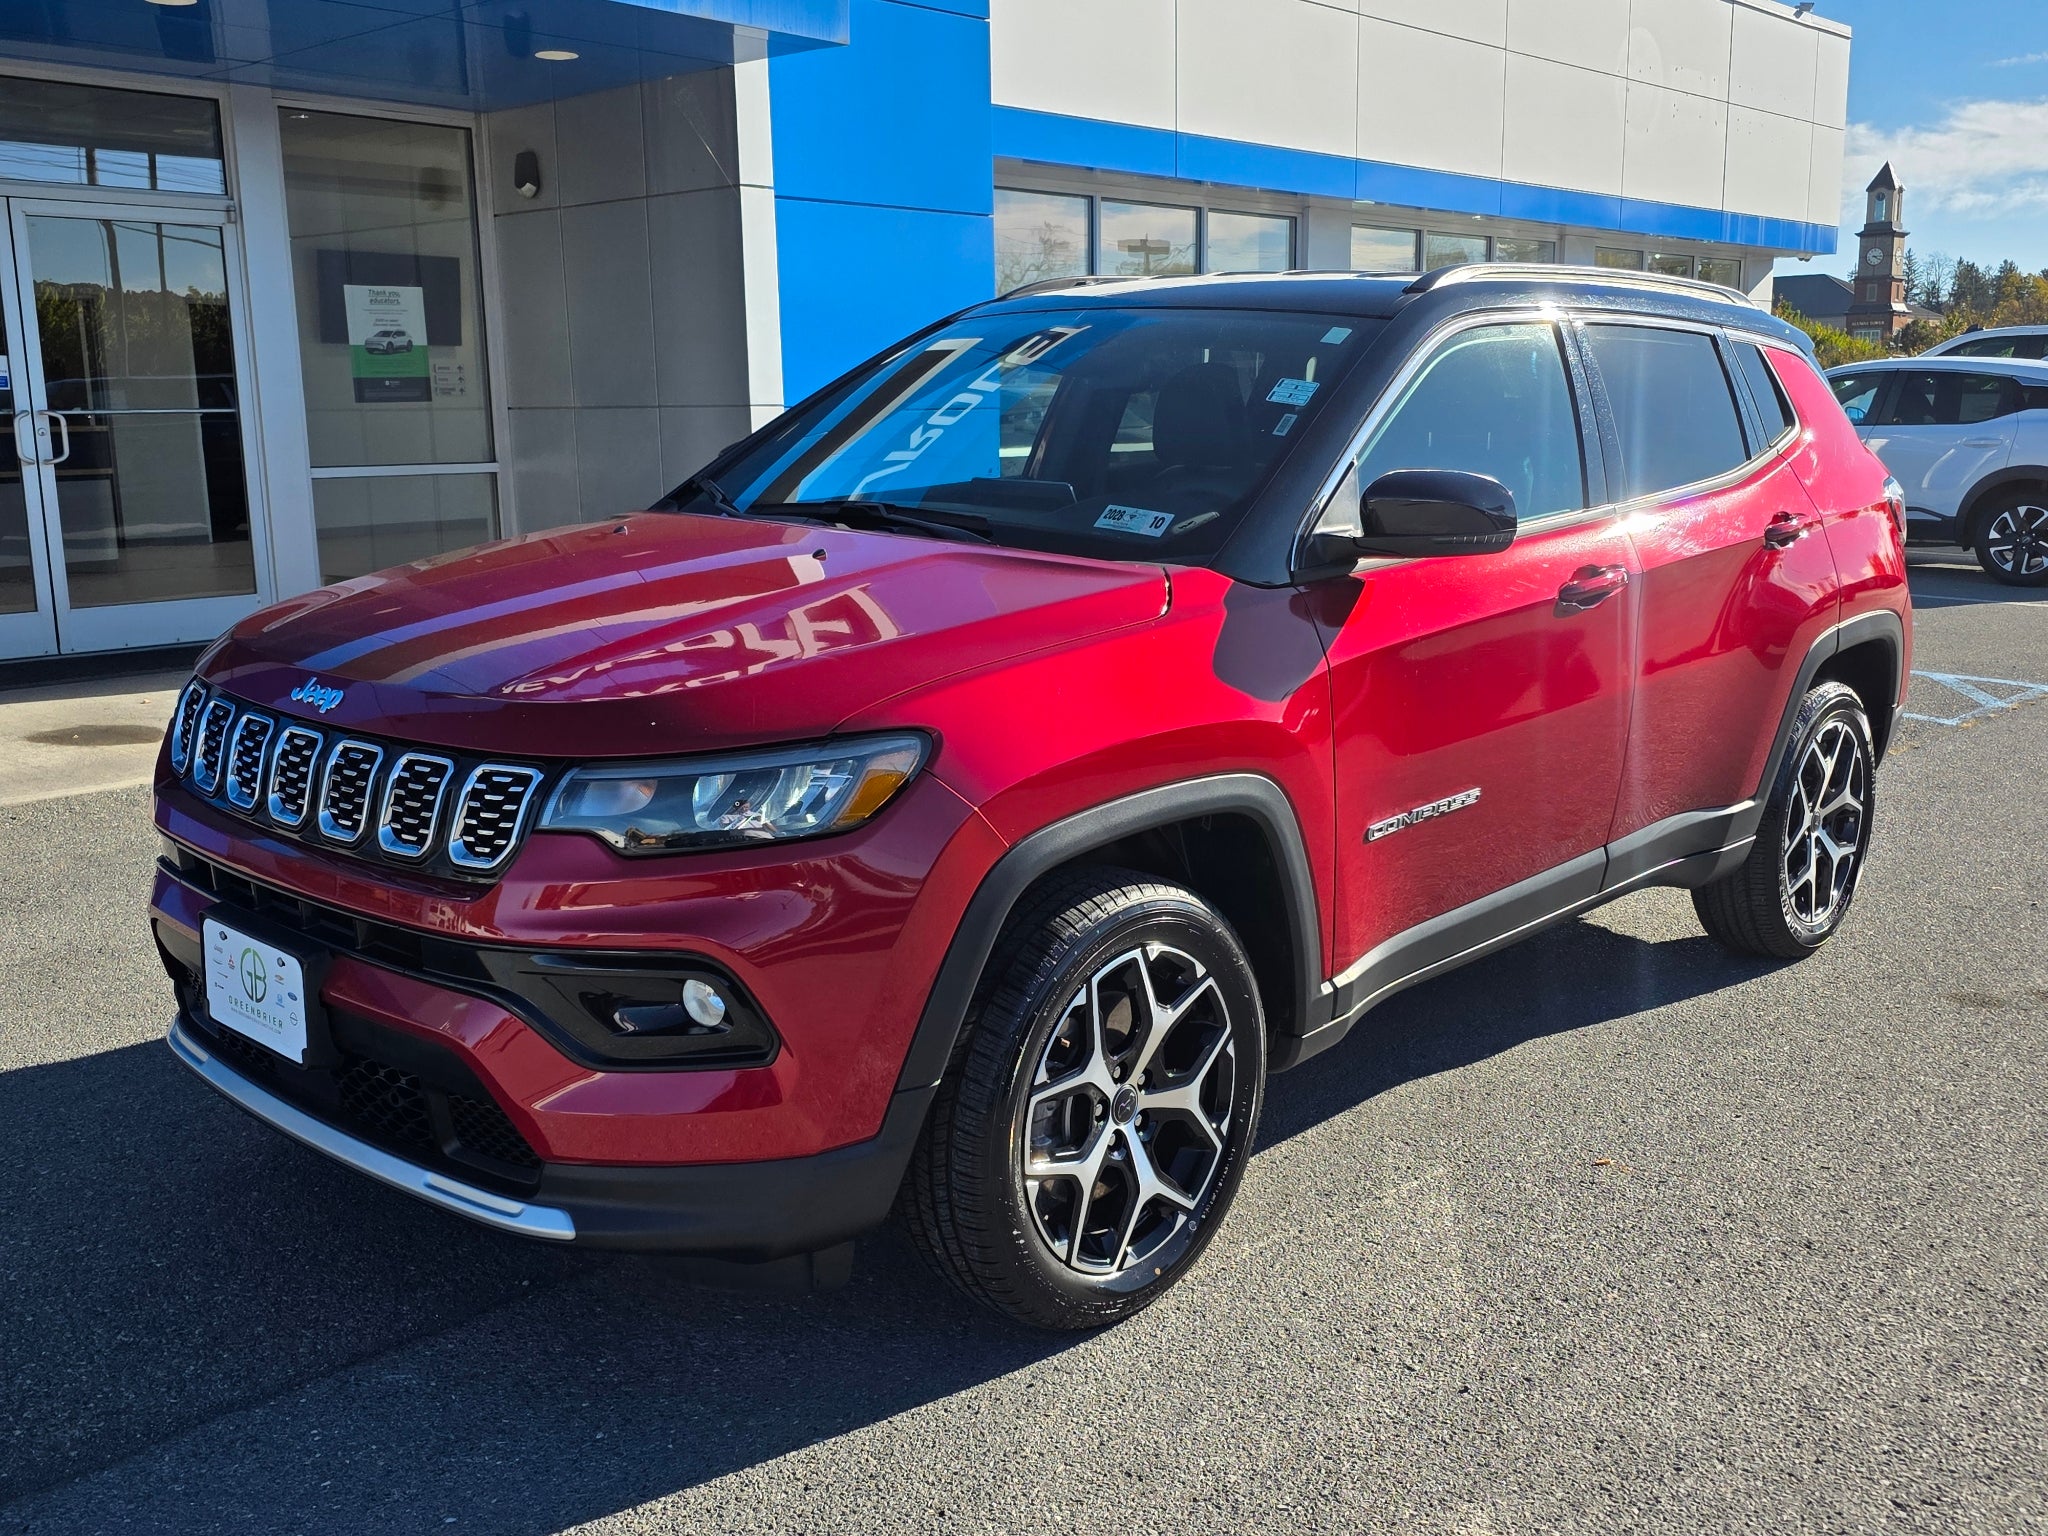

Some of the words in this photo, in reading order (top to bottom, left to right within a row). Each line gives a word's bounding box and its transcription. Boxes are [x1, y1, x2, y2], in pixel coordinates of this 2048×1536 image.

[368, 288, 387, 296] Thank
[1148, 515, 1166, 530] 10
[291, 677, 344, 713] Jeep
[1367, 787, 1481, 841] COMPASS
[228, 995, 283, 1029] GREENBRIER
